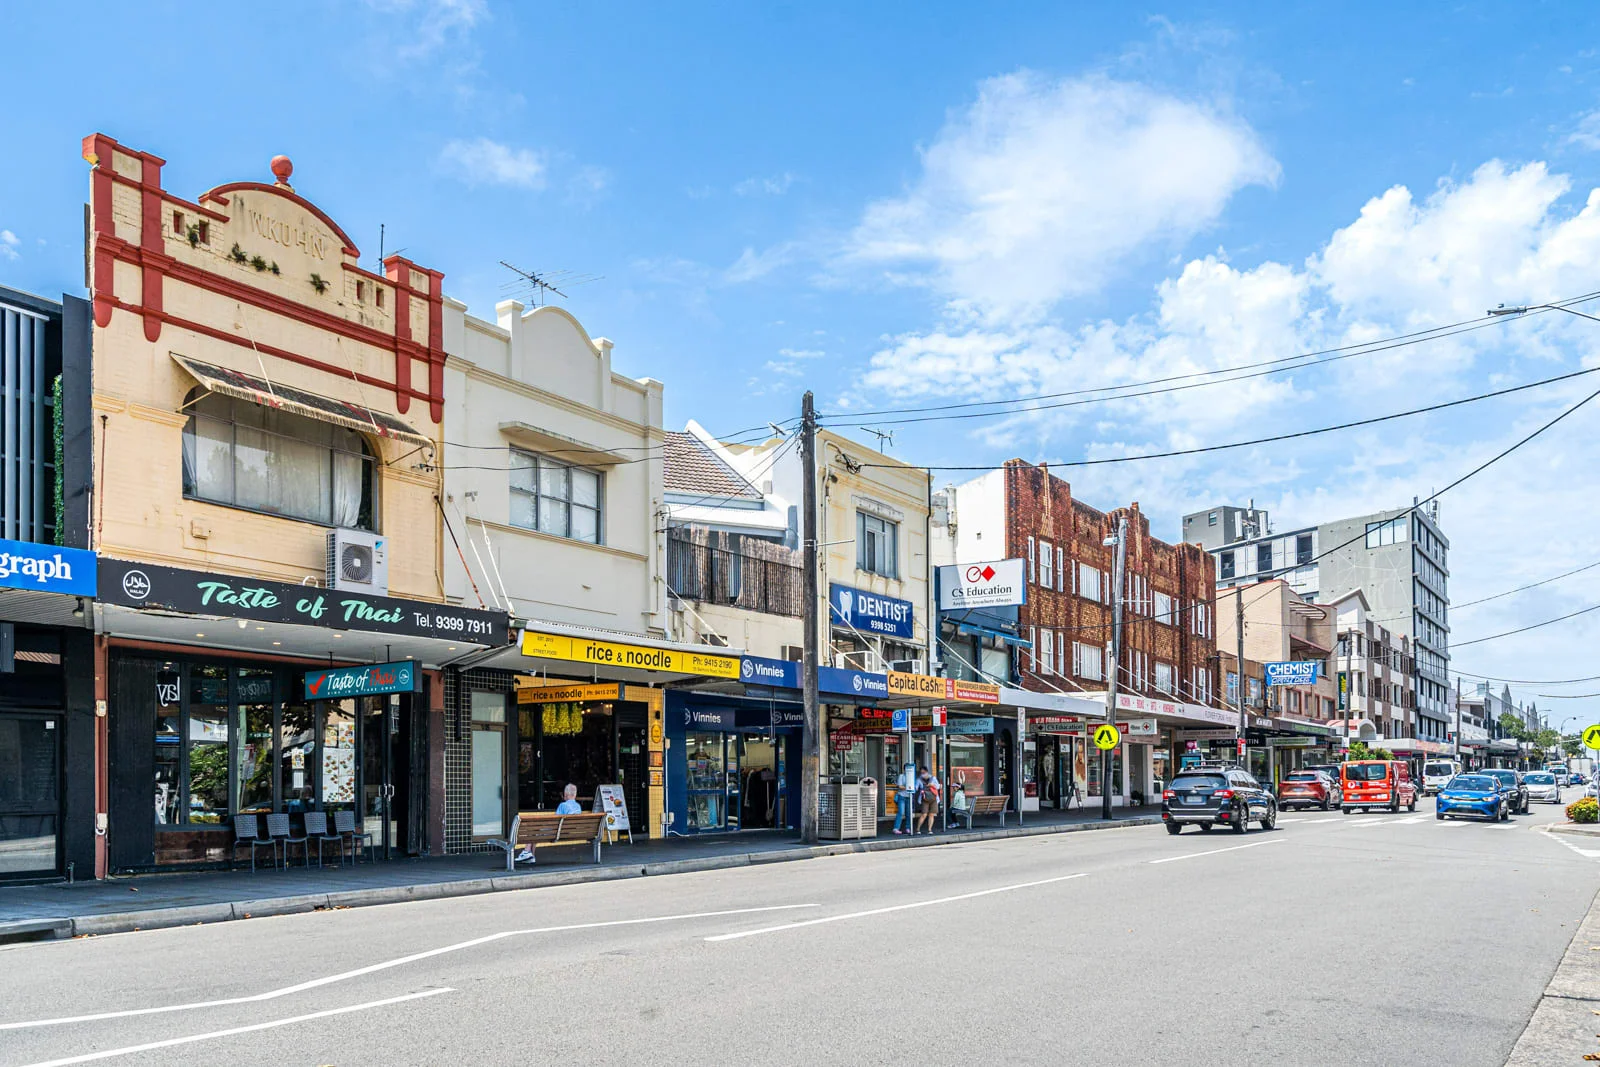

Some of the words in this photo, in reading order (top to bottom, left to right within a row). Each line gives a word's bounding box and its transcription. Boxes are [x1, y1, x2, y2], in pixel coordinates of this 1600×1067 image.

[951, 587, 964, 597] CS
[966, 584, 1012, 597] Education
[197, 581, 282, 609] Taste
[296, 595, 328, 620] of
[340, 599, 405, 624] Thai
[414, 612, 433, 628] Tel.
[435, 615, 464, 631] 9399
[467, 619, 492, 635] 7911
[858, 595, 908, 623] DENTIST
[870, 620, 884, 631] 9398
[884, 623, 897, 633] 5251
[586, 642, 613, 661] rice
[616, 652, 623, 662] &
[626, 648, 672, 669] noodle
[704, 657, 718, 667] 9415
[755, 663, 785, 678] Vinnies
[1268, 663, 1316, 675] CHEMIST
[327, 673, 356, 690] Taste
[356, 669, 370, 690] of
[370, 668, 397, 686] Thai
[862, 678, 887, 692] Vinnies
[889, 674, 919, 692] Capital
[920, 678, 940, 694] Ca$h
[533, 690, 548, 700] rice
[554, 688, 583, 699] noodle
[692, 711, 721, 723] Vinnies
[784, 713, 803, 721] Vinni
[978, 719, 990, 727] City
[1055, 721, 1083, 730] Education
